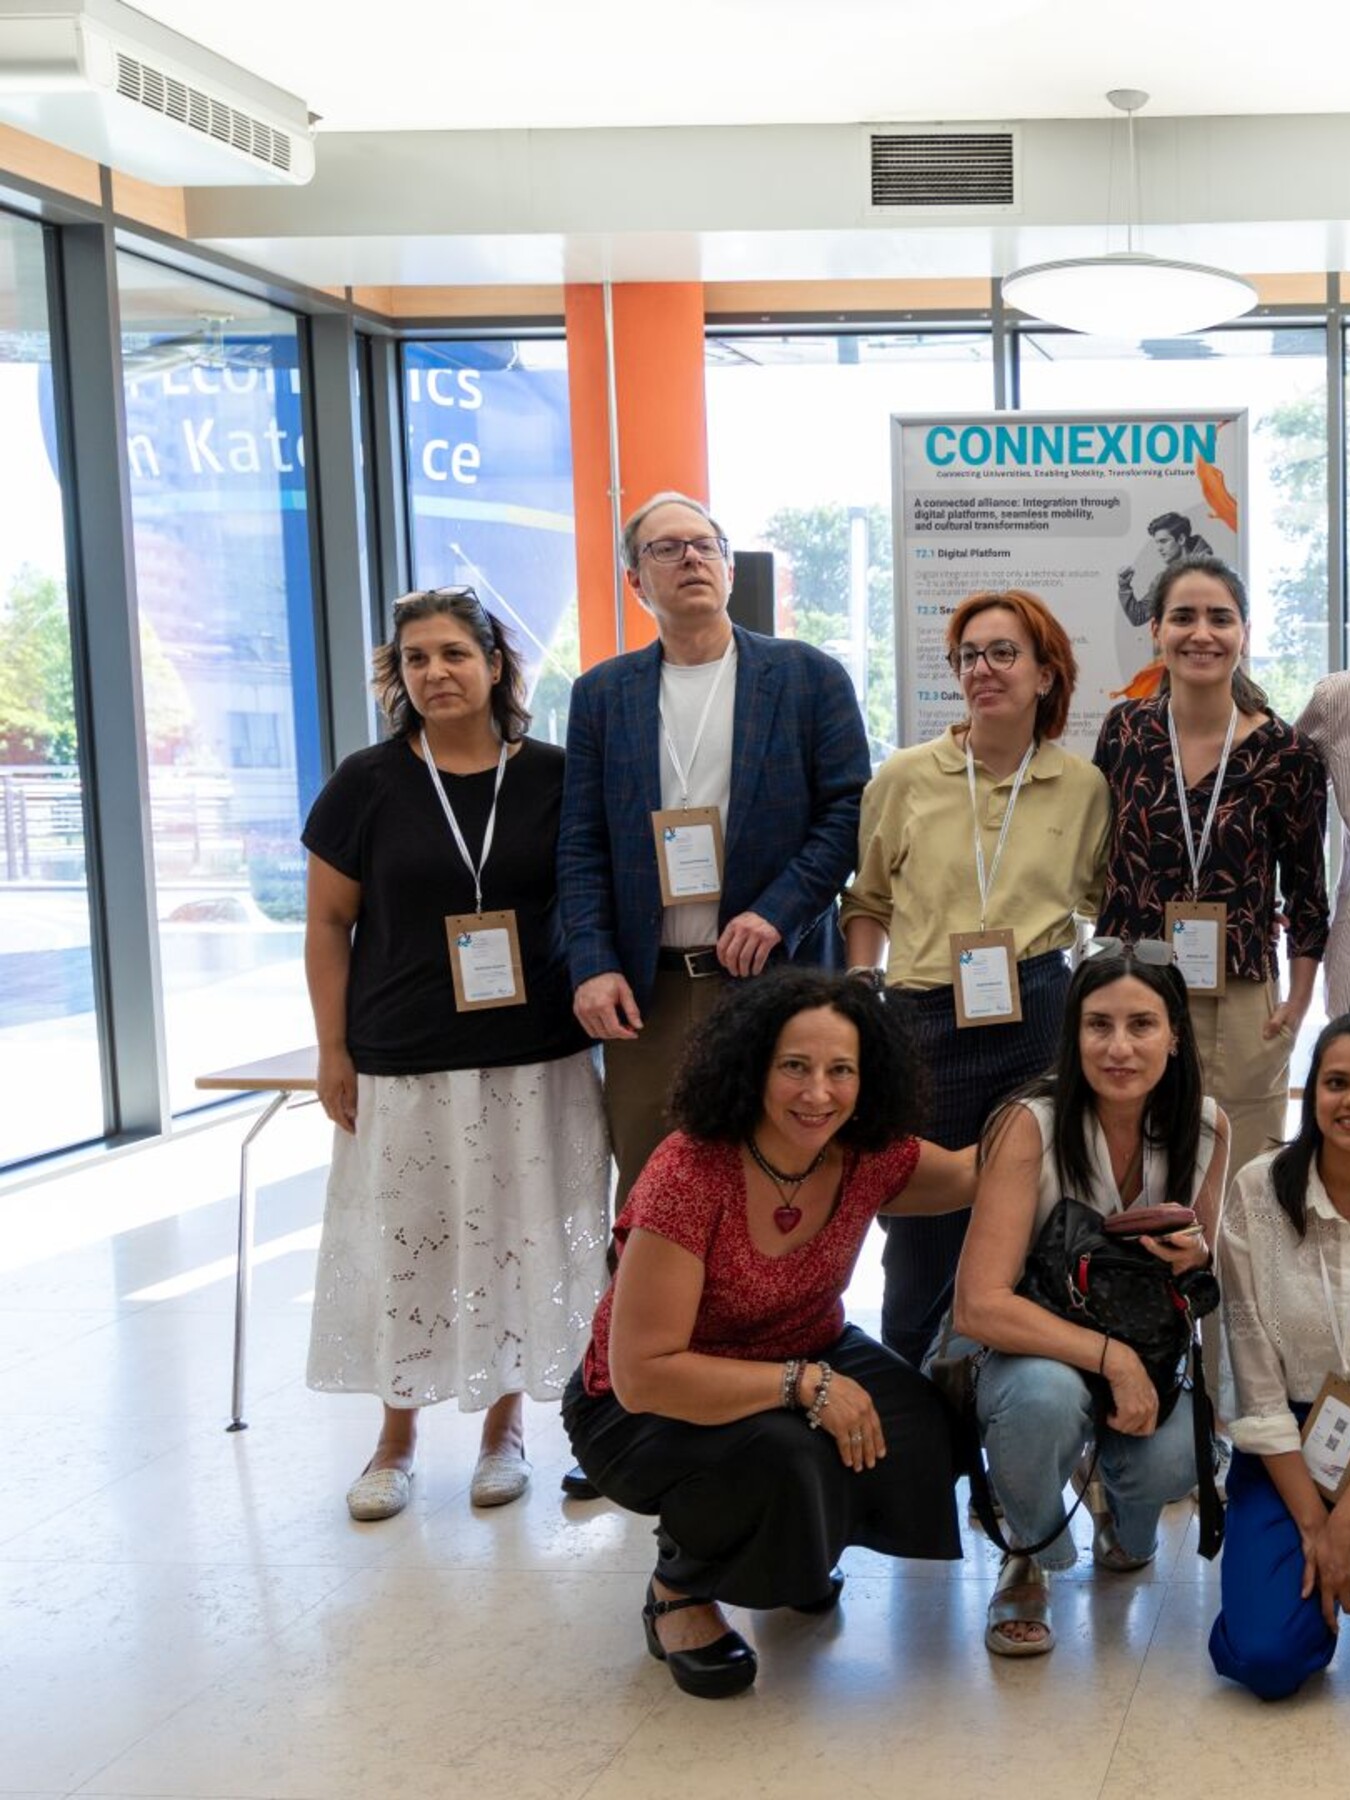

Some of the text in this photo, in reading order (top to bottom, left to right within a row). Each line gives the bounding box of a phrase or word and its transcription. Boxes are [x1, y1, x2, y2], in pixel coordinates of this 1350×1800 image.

[127, 417, 482, 485] n Katce
[926, 424, 1217, 466] CONNEXION
[1035, 470, 1069, 479] Enabling
[1108, 469, 1162, 478] Transforming
[1165, 469, 1196, 477] Culture
[914, 497, 1120, 509] A connected alliance: Integration through
[914, 509, 1094, 520] digital platforms, seamless mobility,
[914, 520, 1049, 530] and cultural transformation
[938, 548, 967, 560] Digital
[970, 548, 1010, 557] Platform
